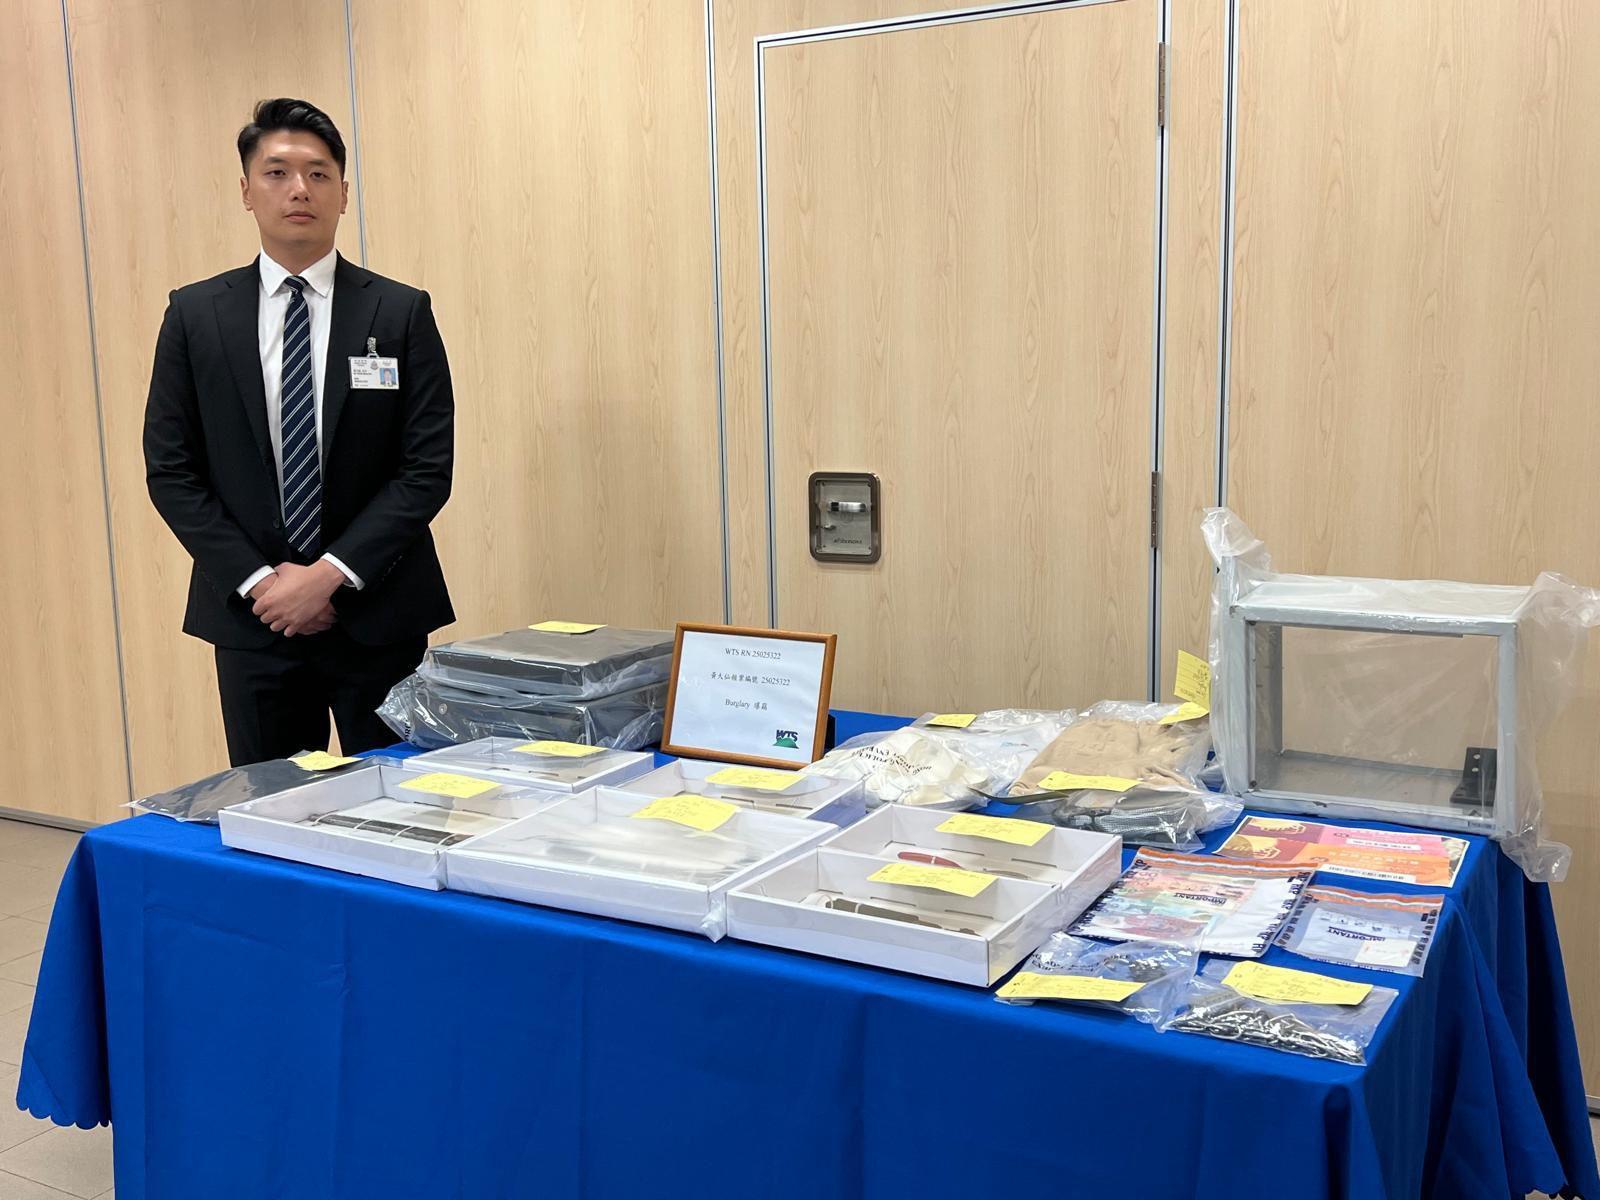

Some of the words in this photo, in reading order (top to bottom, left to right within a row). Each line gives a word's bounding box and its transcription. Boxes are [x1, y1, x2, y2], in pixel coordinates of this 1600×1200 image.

[725, 648, 739, 656] WTS
[740, 649, 751, 657] RN
[752, 650, 781, 660] 25025322
[761, 676, 790, 686] 25025322
[725, 698, 750, 709] Burglary
[776, 729, 798, 742] WTS
[1173, 892, 1227, 906] IMPORTANT
[1327, 926, 1386, 941] IMPORTANT
